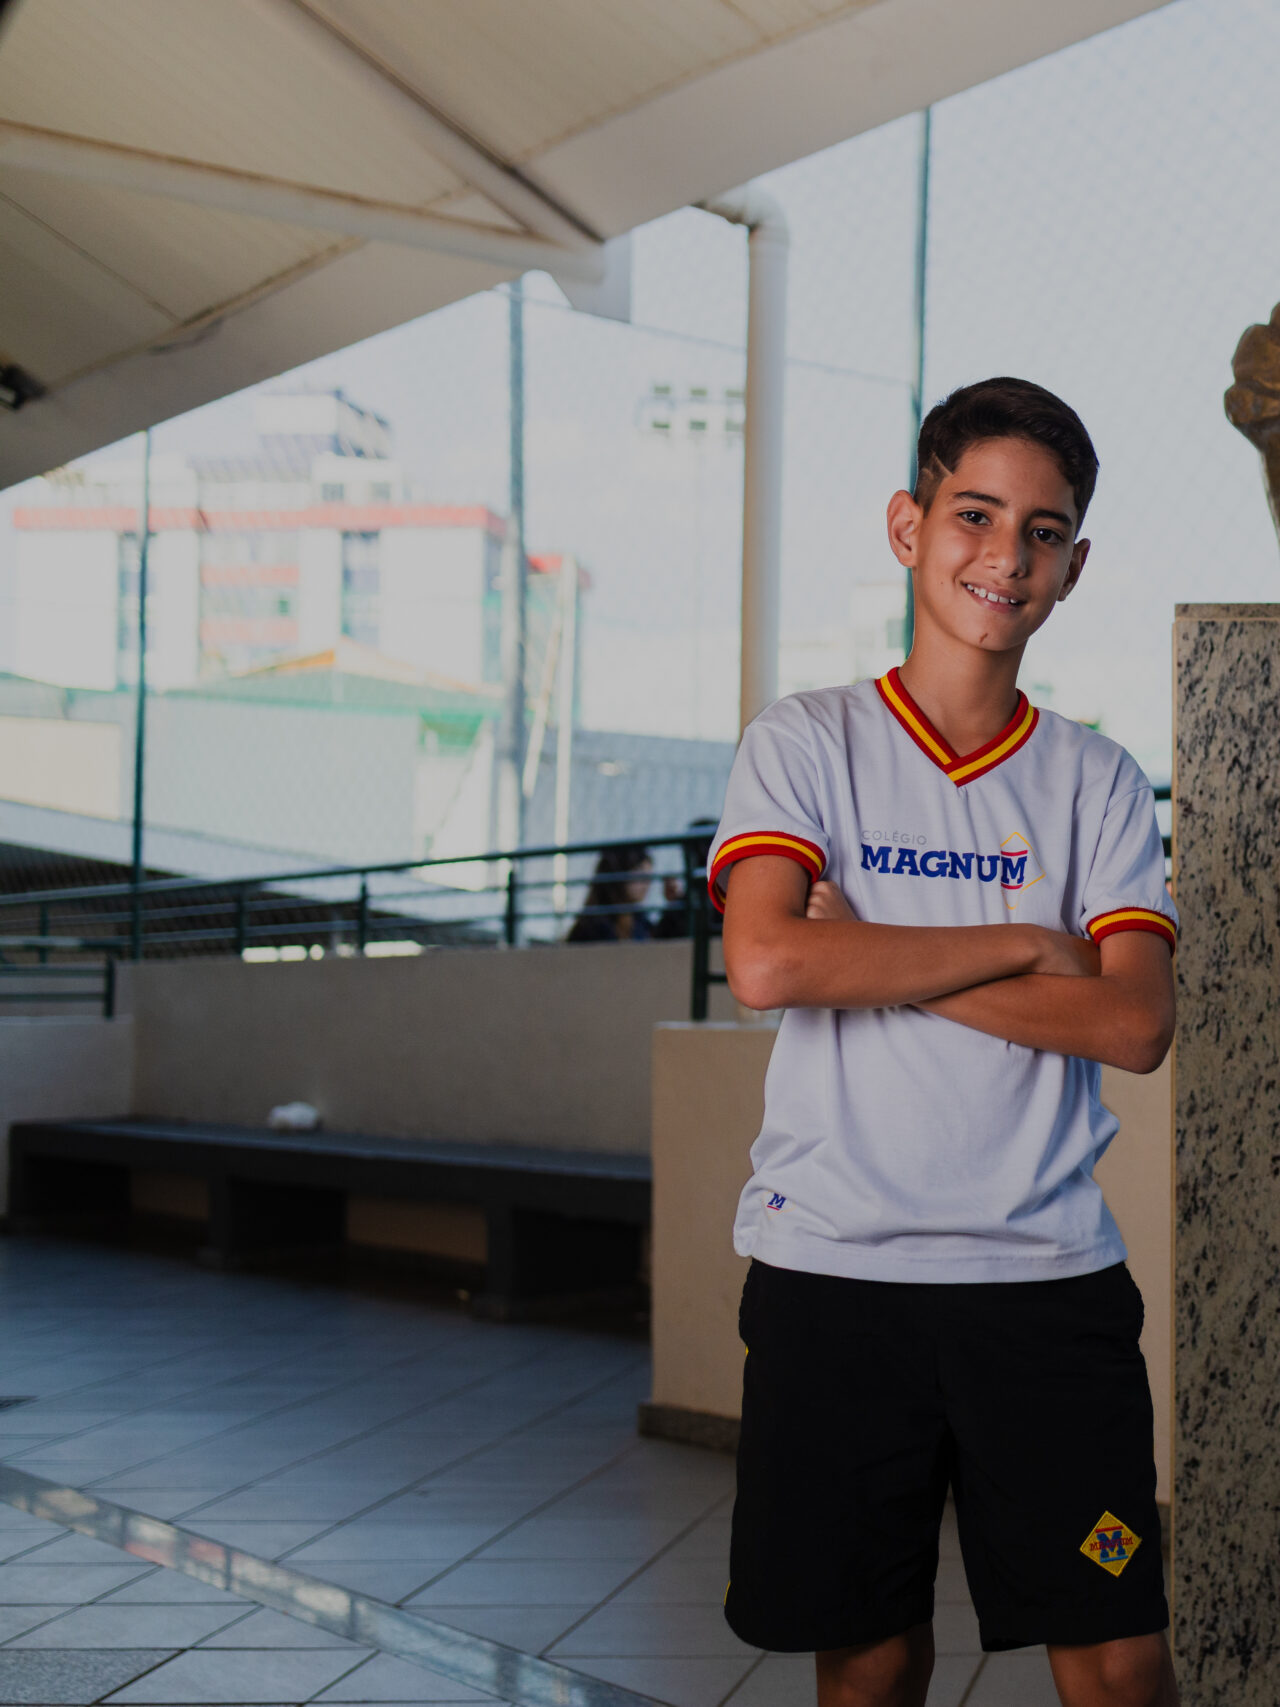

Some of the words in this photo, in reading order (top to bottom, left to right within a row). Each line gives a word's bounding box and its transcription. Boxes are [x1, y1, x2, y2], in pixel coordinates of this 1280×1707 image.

[861, 830, 927, 845] COLÉGIO
[861, 843, 1028, 883] MAGNUM
[768, 1193, 786, 1208] M
